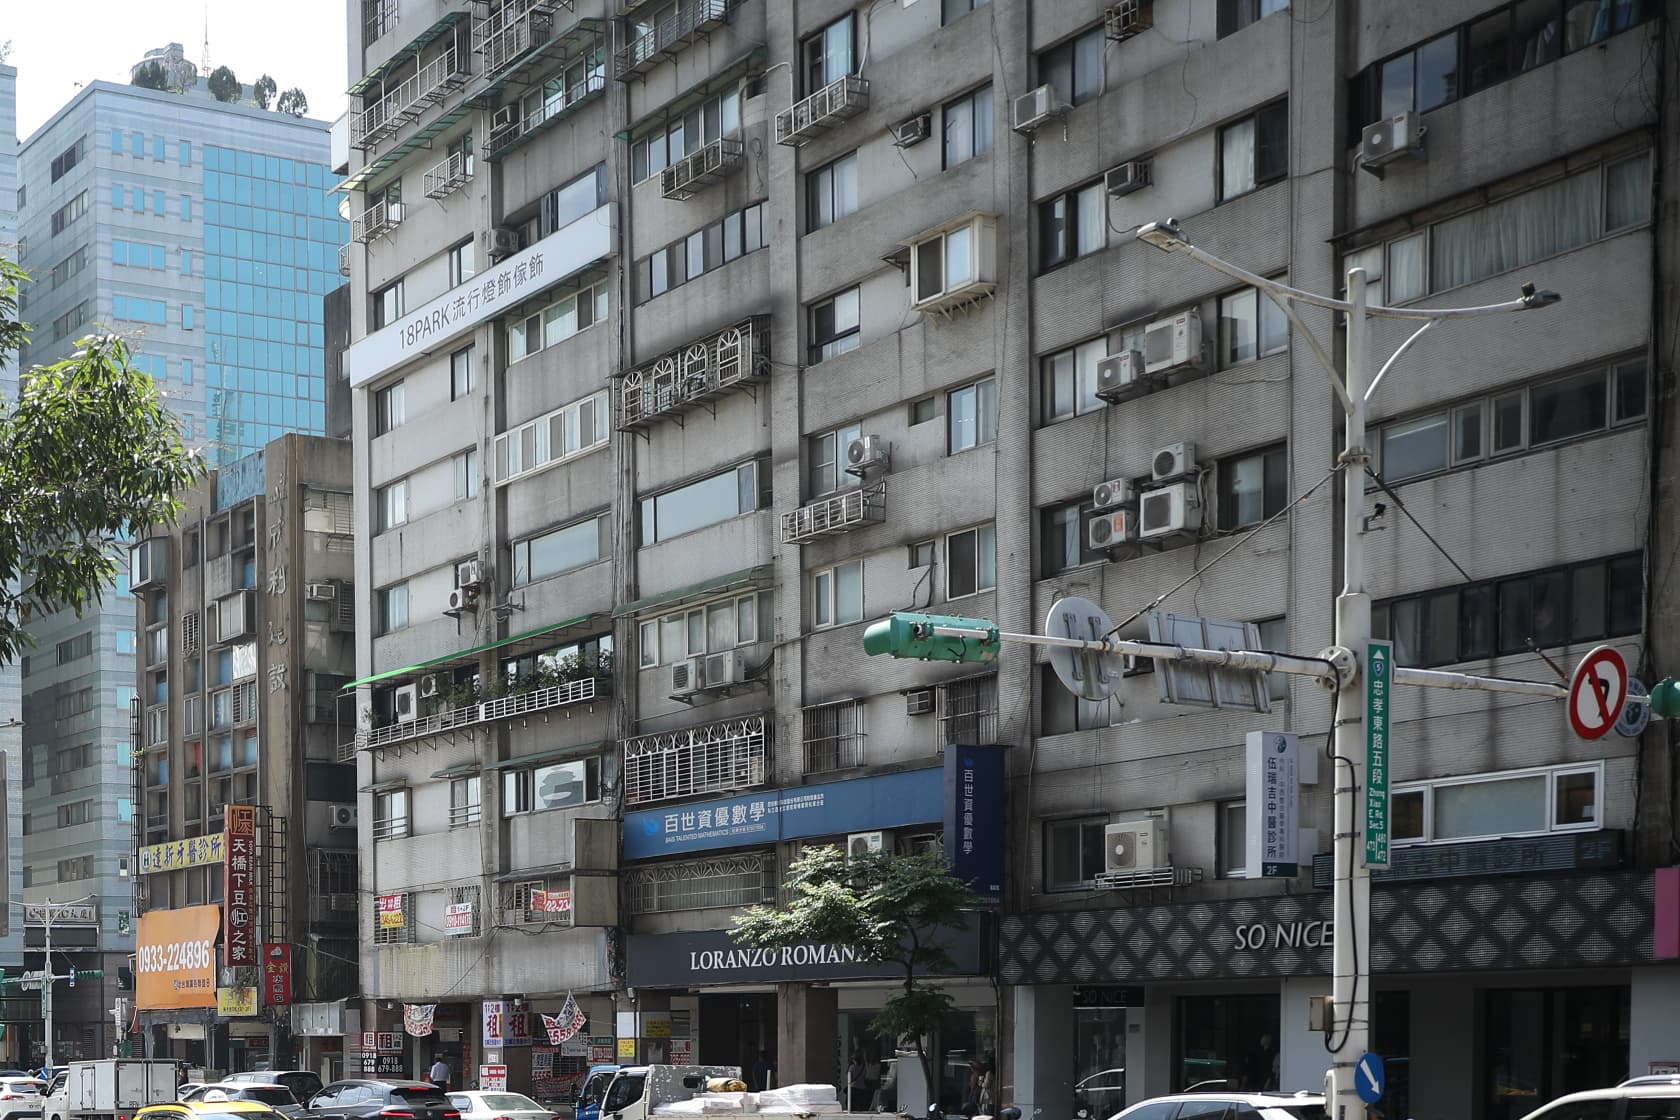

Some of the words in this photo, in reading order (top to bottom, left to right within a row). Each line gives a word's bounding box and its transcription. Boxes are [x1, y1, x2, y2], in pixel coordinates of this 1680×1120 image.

[1372, 680, 1384, 785] 忠孝東路五段
[1369, 787, 1385, 800] Zhong
[1370, 799, 1381, 808] Xiao
[665, 801, 765, 833] 百世資優數學
[963, 769, 974, 855] 百世資優數學
[1267, 866, 1277, 875] 2F
[1234, 924, 1265, 949] SO
[1275, 921, 1334, 948] NICE
[139, 940, 210, 973] 0933-224896
[690, 948, 776, 970] LORANZO
[780, 944, 882, 966] ROMAN
[487, 1014, 499, 1038] 租
[509, 1014, 527, 1038] 租
